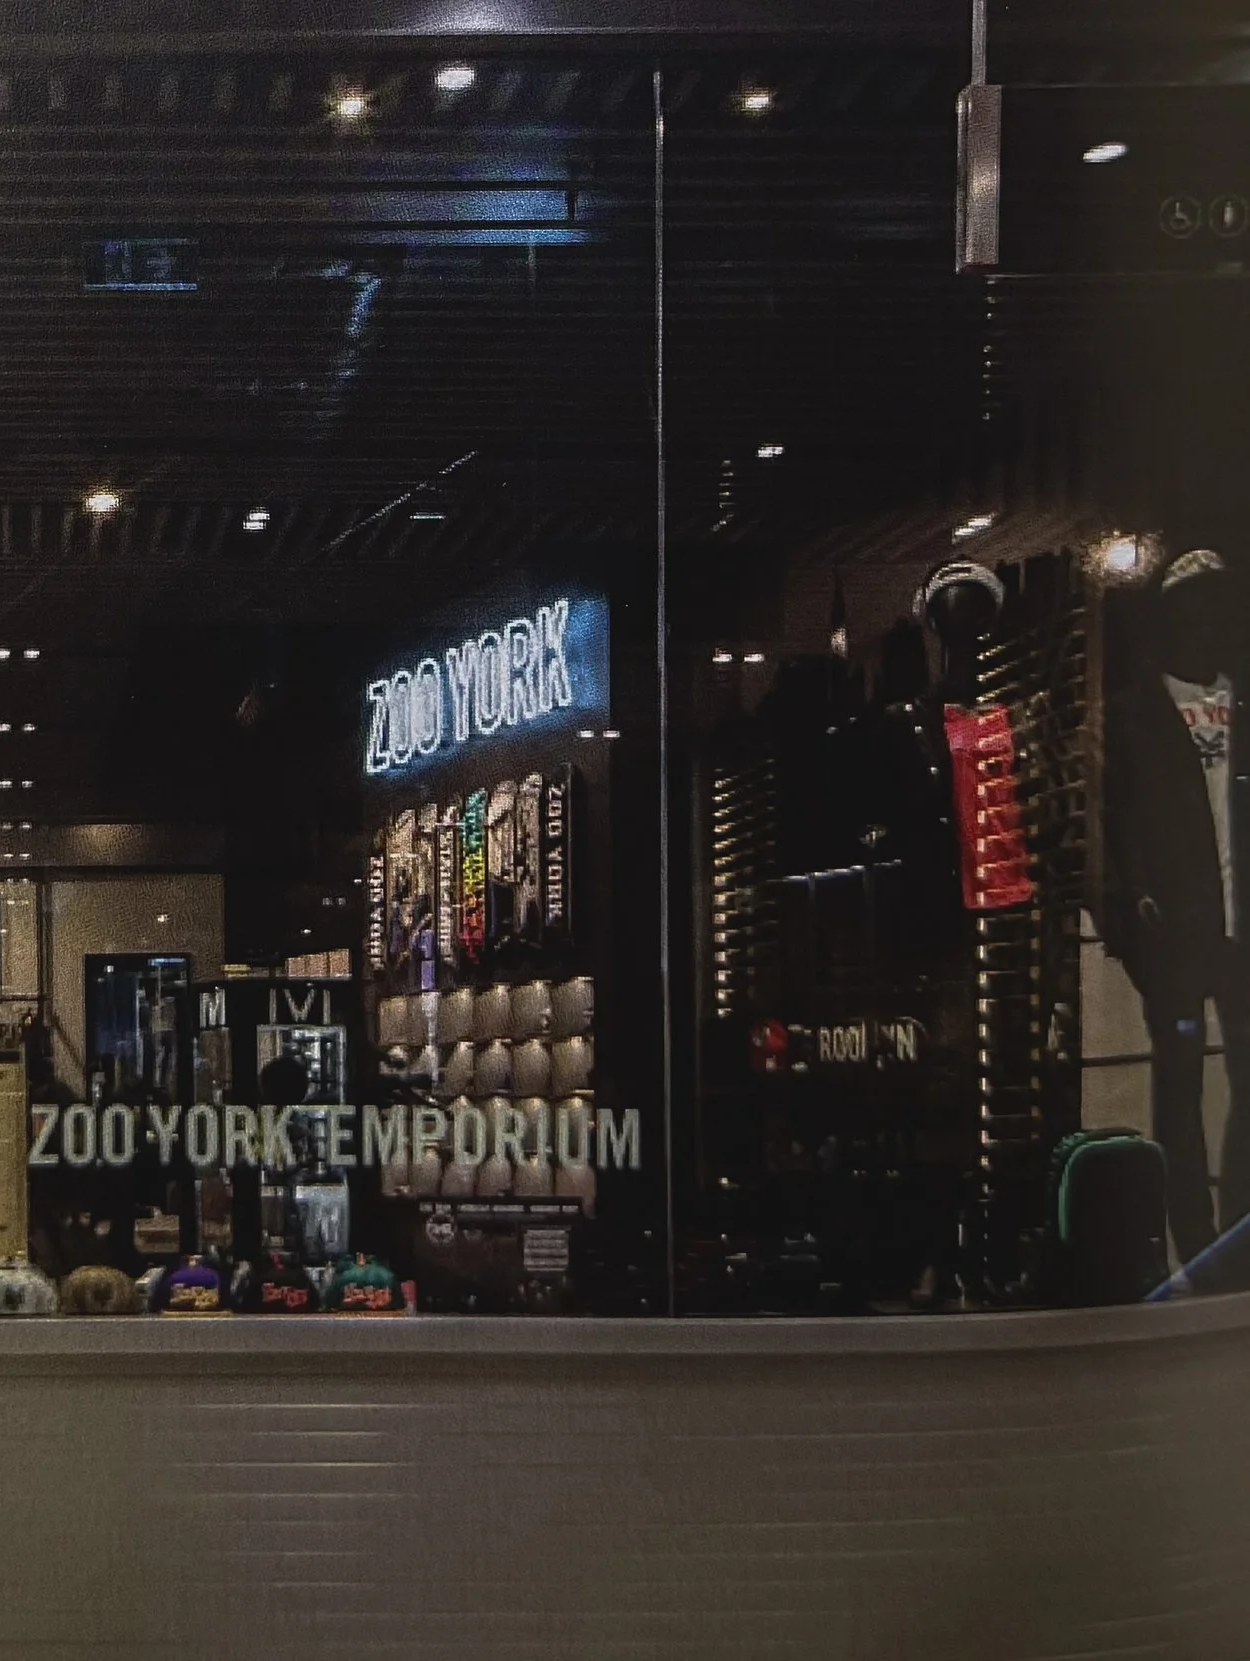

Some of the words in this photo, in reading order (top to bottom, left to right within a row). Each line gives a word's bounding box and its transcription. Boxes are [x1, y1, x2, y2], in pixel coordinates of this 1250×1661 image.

[365, 656, 442, 773] ZOO
[446, 597, 572, 741] YORK
[29, 1103, 136, 1166] ZOO
[146, 1104, 296, 1170] YORK
[327, 1104, 642, 1170] EMPORIUM
